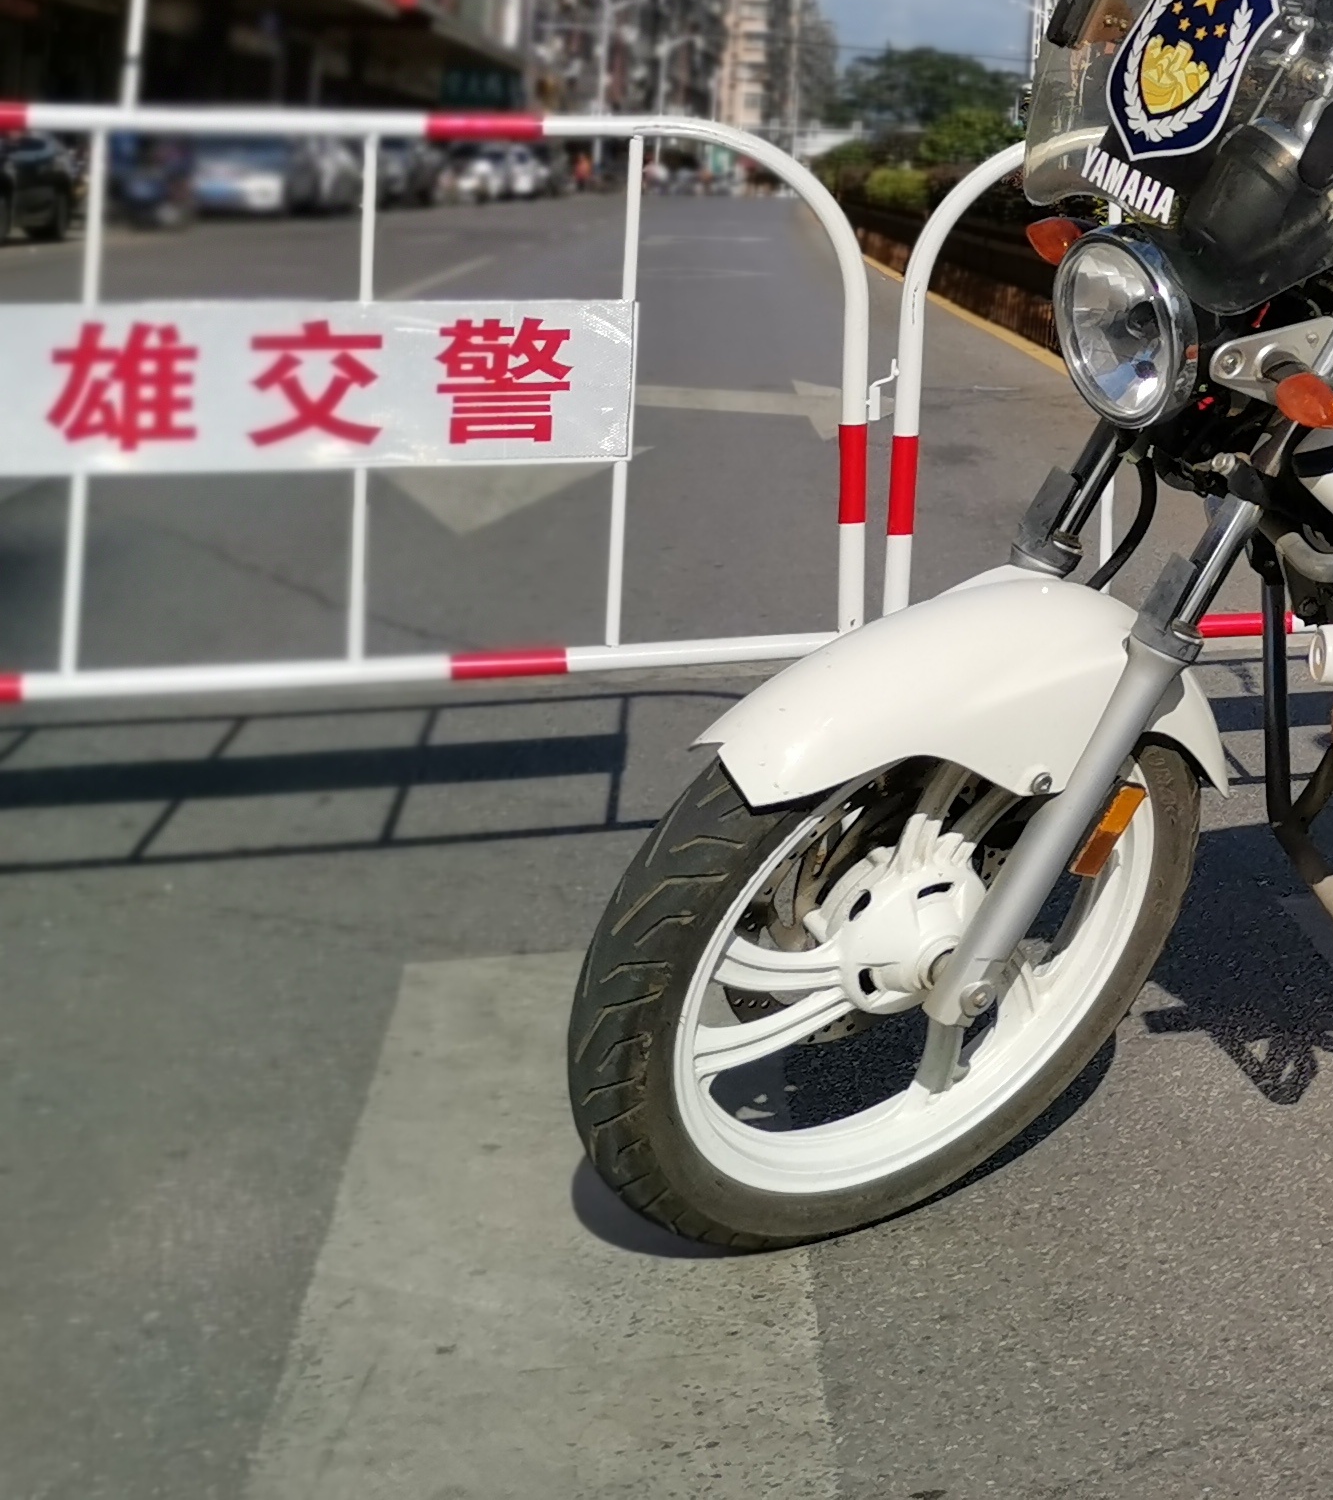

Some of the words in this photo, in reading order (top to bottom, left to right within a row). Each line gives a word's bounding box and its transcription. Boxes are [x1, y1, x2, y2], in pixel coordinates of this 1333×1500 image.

[1080, 143, 1175, 225] YAMAHA
[47, 316, 574, 452] 雄交警
